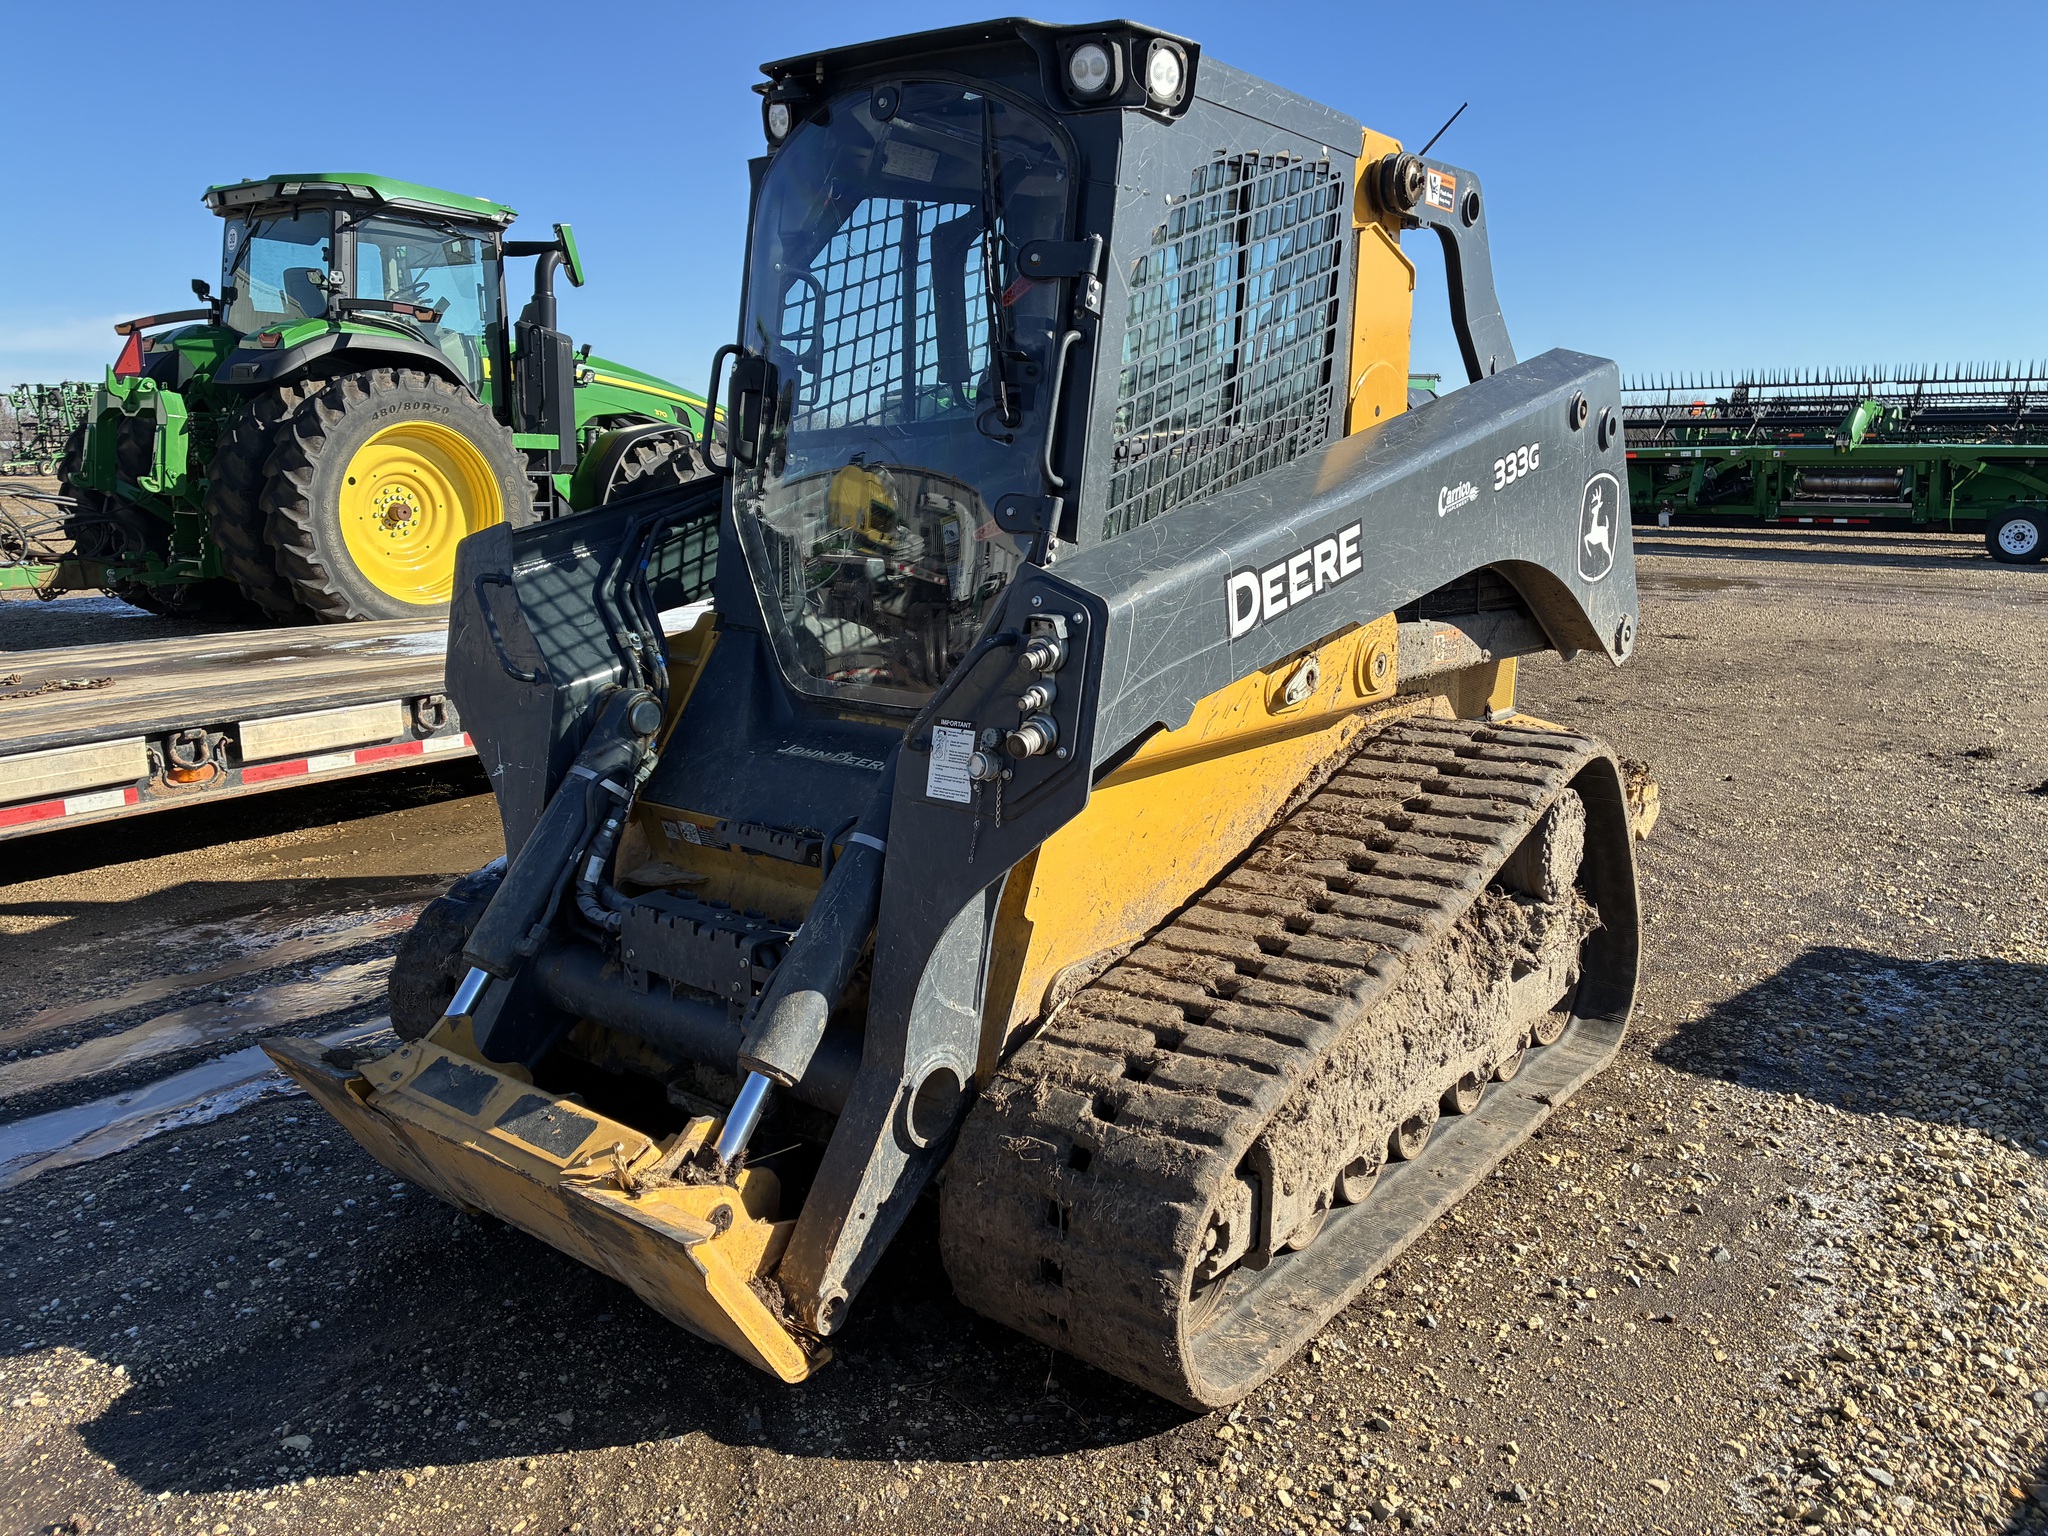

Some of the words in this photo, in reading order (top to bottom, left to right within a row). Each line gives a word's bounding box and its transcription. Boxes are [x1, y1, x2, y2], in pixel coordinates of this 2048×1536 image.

[371, 402, 450, 420] 480/80R50
[1494, 442, 1540, 492] 333G
[1438, 481, 1471, 518] Carrico
[1226, 522, 1363, 638] DEERE
[940, 719, 972, 729] IMPORTANT
[777, 744, 832, 759] JOHN
[831, 752, 886, 771] DEER
